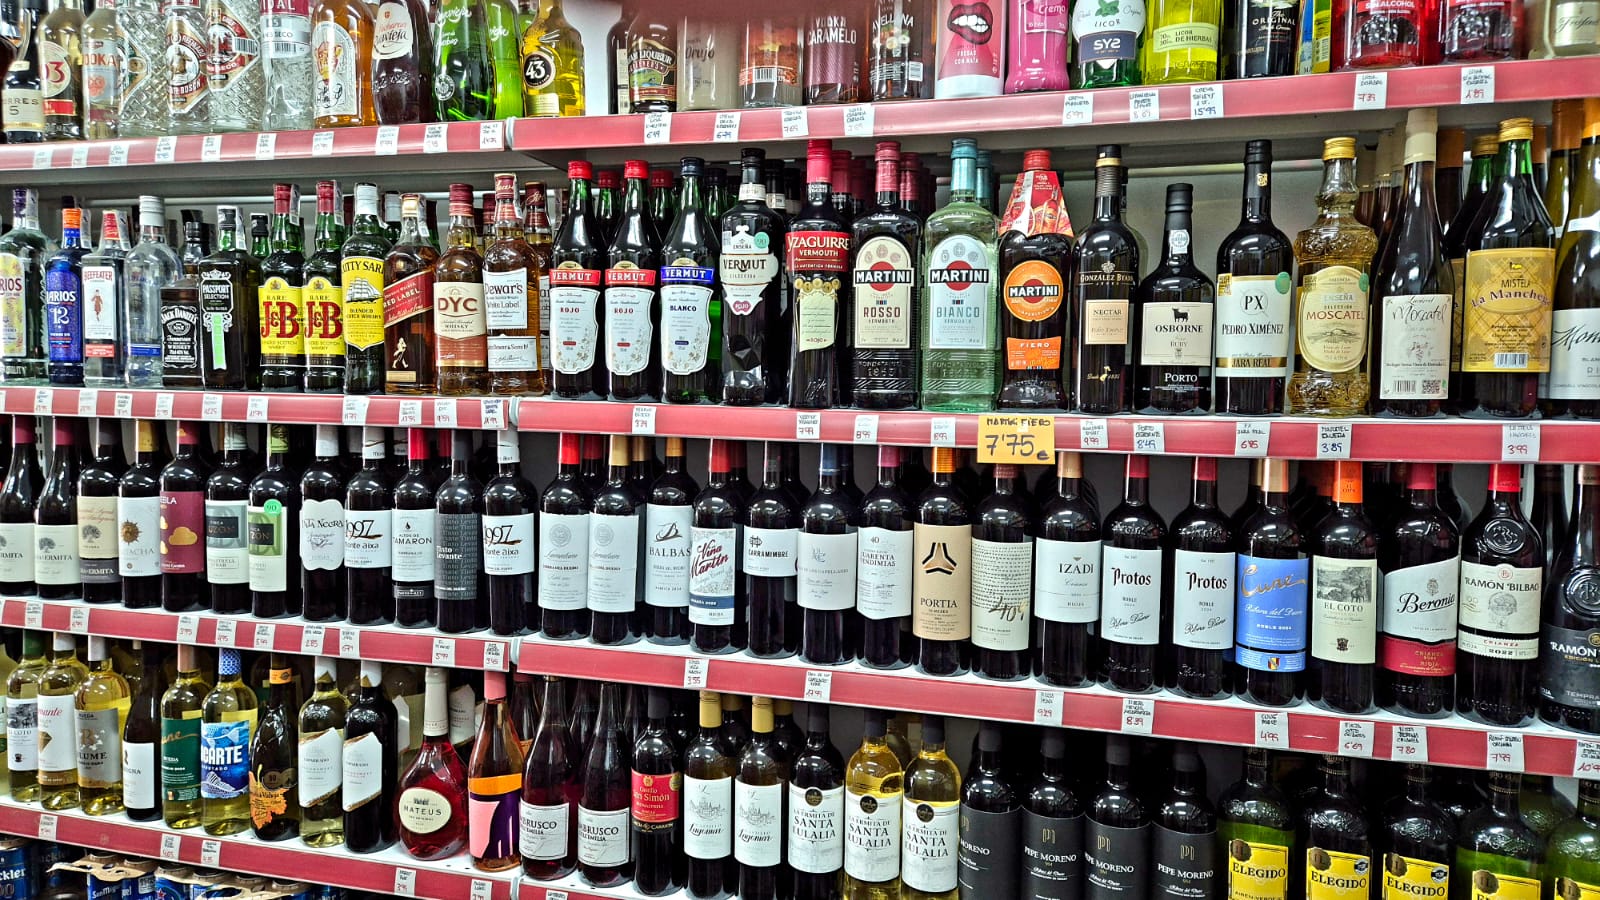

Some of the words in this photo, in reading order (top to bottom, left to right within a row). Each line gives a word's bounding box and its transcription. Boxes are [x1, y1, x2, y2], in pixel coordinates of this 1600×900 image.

[816, 16, 847, 28] VODKA
[1252, 19, 1296, 28] ORIGINAL
[808, 30, 857, 46] CARAMELO
[525, 61, 546, 81] 43
[799, 249, 839, 257] VERMOUTH
[723, 259, 767, 272] VERMUT
[83, 270, 114, 281] BEEFEATER
[552, 271, 592, 283] VERMUT
[608, 271, 647, 283] VERMUT
[665, 268, 707, 281] VERMUT
[856, 270, 912, 284] MARTINI
[931, 269, 989, 283] MARTINI
[0, 279, 22, 290] RIOS
[485, 283, 523, 295] Dewar's
[384, 297, 397, 308] RED
[396, 287, 421, 304] LABEL
[1009, 285, 1059, 298] MARTINI
[438, 297, 478, 313] DYC
[1245, 294, 1266, 312] PX
[863, 307, 901, 318] ROSSO
[936, 307, 980, 319] BIANCO
[1306, 310, 1365, 320] MOSCATEL
[262, 301, 300, 339] J&B
[304, 301, 343, 340] J&B
[1154, 324, 1203, 333] OSBORNE
[1221, 323, 1247, 336] PEDRO
[1164, 372, 1198, 383] PORTO
[1020, 418, 1051, 427] FIERO
[266, 503, 278, 513] 90
[649, 547, 692, 558] BALBAS
[861, 551, 896, 561] UARENTA
[861, 560, 897, 568] ENDIMIAS
[1059, 563, 1095, 575] IZADI
[1111, 566, 1152, 587] Protos
[1186, 572, 1228, 591] Protos
[920, 597, 959, 609] PORTIA
[1338, 602, 1364, 613] COTO
[1550, 641, 1598, 657] RAMÓN
[521, 820, 558, 830] BRUSCO
[794, 815, 834, 829] SANTA
[580, 823, 620, 836] BRUSCO
[792, 827, 837, 840] EULALIA
[849, 822, 889, 837] SANTA
[848, 834, 892, 848] EULALIA
[906, 831, 946, 847] SANTA
[905, 843, 949, 858] EULALIA
[1024, 846, 1041, 859] PEPE
[1041, 853, 1078, 867] MORENO
[1095, 859, 1135, 874] MORENO
[1157, 863, 1177, 875] PEPE
[1177, 868, 1214, 879] MORENO
[1233, 863, 1287, 879] ELEGIDO
[0, 867, 26, 882] ckler
[1310, 871, 1368, 889] ELEGIDO
[1387, 876, 1446, 897] ELEGIDO
